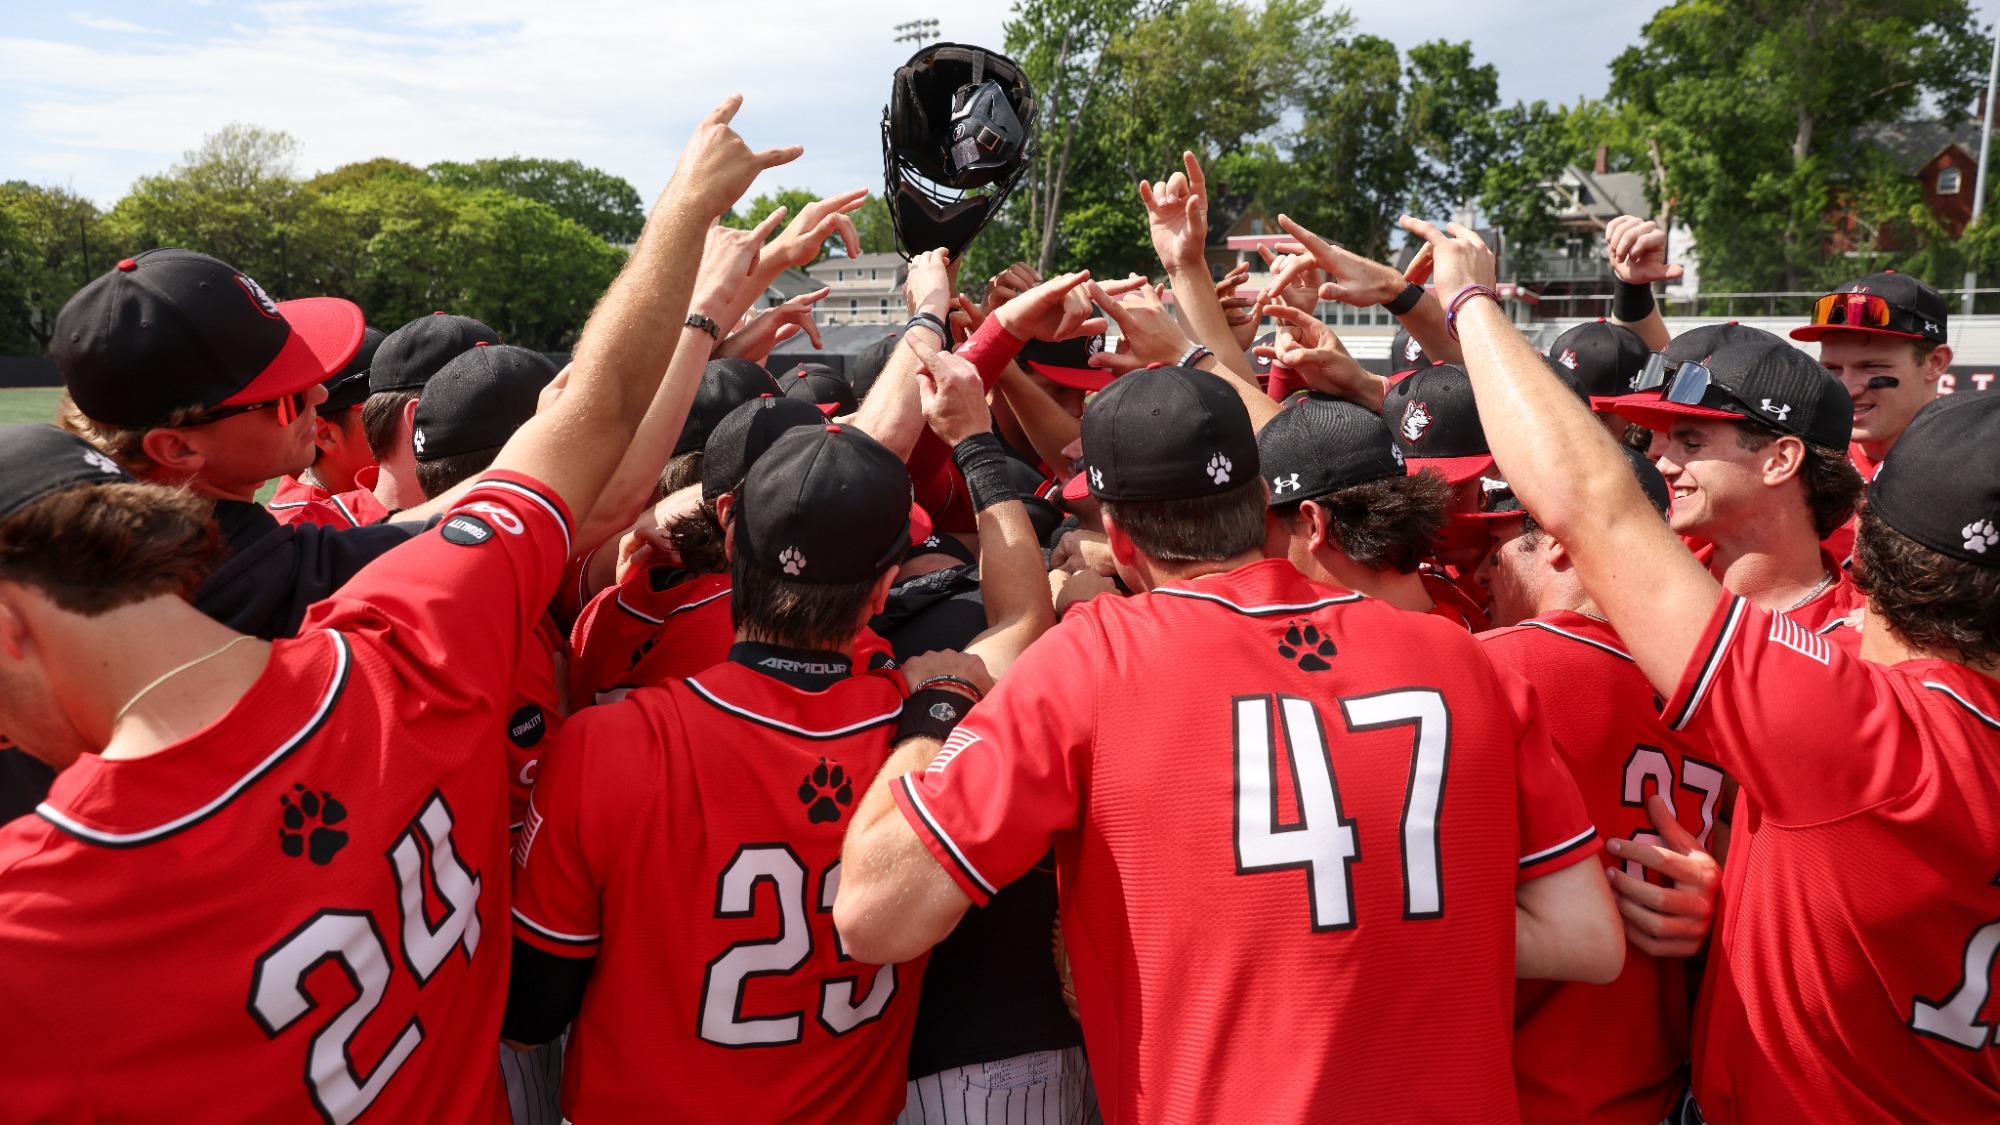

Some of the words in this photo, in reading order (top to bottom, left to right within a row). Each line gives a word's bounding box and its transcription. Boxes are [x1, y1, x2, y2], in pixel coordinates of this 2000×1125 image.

[447, 519, 488, 540] EQUALITY
[757, 657, 848, 675] ARMOUR
[512, 714, 542, 737] EQUALITY
[1231, 686, 1452, 933] 47
[246, 787, 483, 1125] 24
